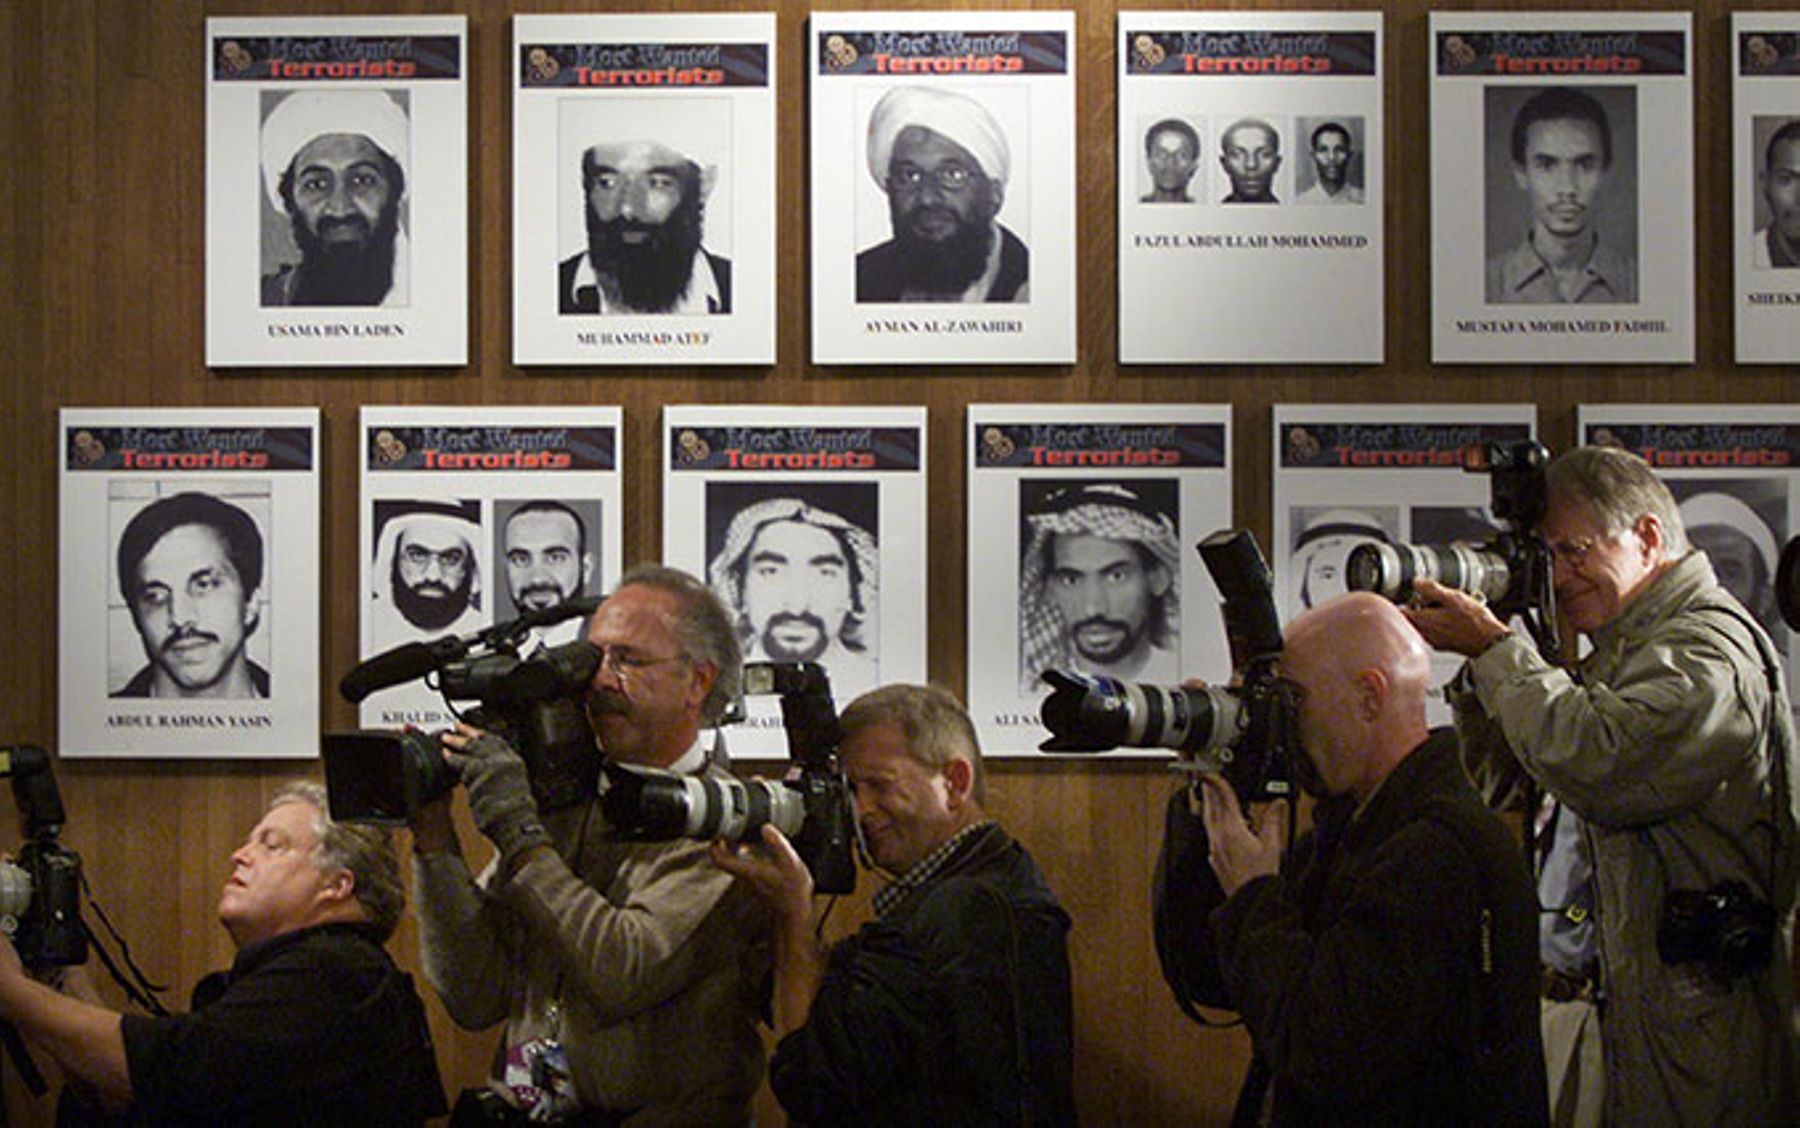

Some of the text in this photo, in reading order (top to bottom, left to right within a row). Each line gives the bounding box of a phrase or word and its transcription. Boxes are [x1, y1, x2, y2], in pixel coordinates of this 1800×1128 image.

[331, 38, 413, 58] Wanted
[935, 32, 1021, 53] Wanted
[1243, 32, 1329, 54] Wanted
[637, 45, 720, 66] Wanted
[873, 53, 1024, 72] Terrorists
[1181, 54, 1331, 72] Terrorists
[1491, 54, 1641, 72] Terrorists
[268, 59, 416, 77] Terrorists
[575, 66, 724, 84] Terrorists
[1187, 234, 1268, 248] ABDULLAH
[1271, 234, 1369, 248] MOHAMMED
[268, 323, 405, 337] USAMA BIN LADEN
[866, 320, 1024, 333] AYMAN AL-ZAWAHIRI
[1456, 320, 1670, 333] MUSTAFA MOHAMED FADHIL
[577, 332, 672, 345] MUHAMMAD
[181, 428, 266, 449] Wanted
[484, 427, 568, 449] Wanted
[787, 427, 872, 449] Wanted
[1092, 424, 1177, 446] Wanted
[119, 449, 269, 468] Terrorists
[422, 449, 571, 468] Terrorists
[725, 449, 876, 468] Terrorists
[1030, 446, 1181, 465] Terrorists
[1335, 446, 1465, 465] Terrorist
[1643, 447, 1790, 465] Terrorists
[107, 715, 272, 728] ABDUL RAHMAN YASIN
[382, 711, 441, 723] KHALID
[994, 714, 1041, 726] ALI SA
